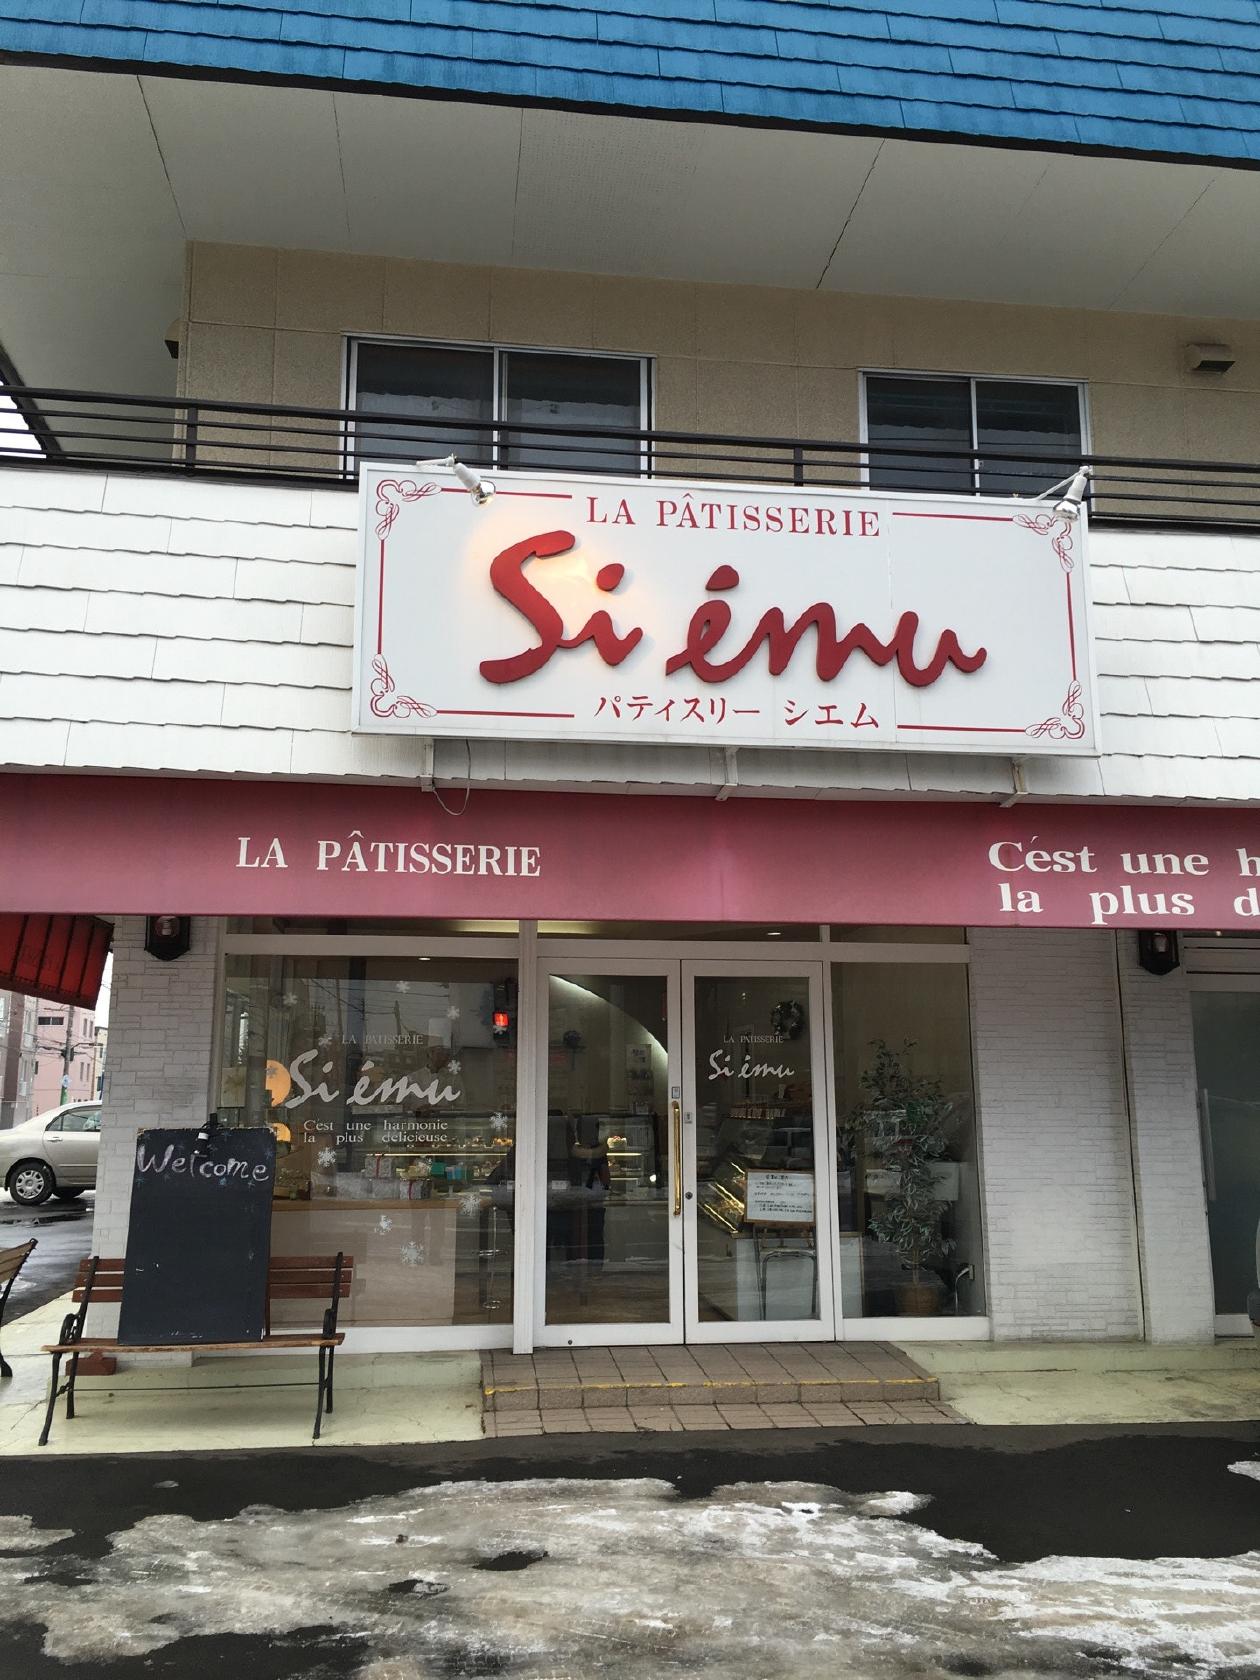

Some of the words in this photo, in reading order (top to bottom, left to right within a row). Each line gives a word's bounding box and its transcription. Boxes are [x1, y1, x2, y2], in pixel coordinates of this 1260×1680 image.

[586, 496, 636, 526] LA
[655, 492, 880, 537] PÂTISSERIE
[479, 529, 643, 685] Si
[593, 695, 761, 725] パティスリー
[783, 699, 880, 729] シエム
[235, 836, 289, 868] LA
[316, 829, 541, 877] PÂTISSERIE
[1120, 853, 1209, 876] une
[998, 882, 1044, 912] la
[1089, 884, 1195, 925] plus
[341, 1034, 357, 1045] LA
[285, 1048, 340, 1109] Si
[708, 1048, 735, 1080] Si
[303, 1131, 316, 1143] la
[336, 1131, 364, 1145] plus
[346, 1121, 373, 1132] une
[383, 1119, 449, 1131] harmonie
[137, 1143, 269, 1182] Welcome
